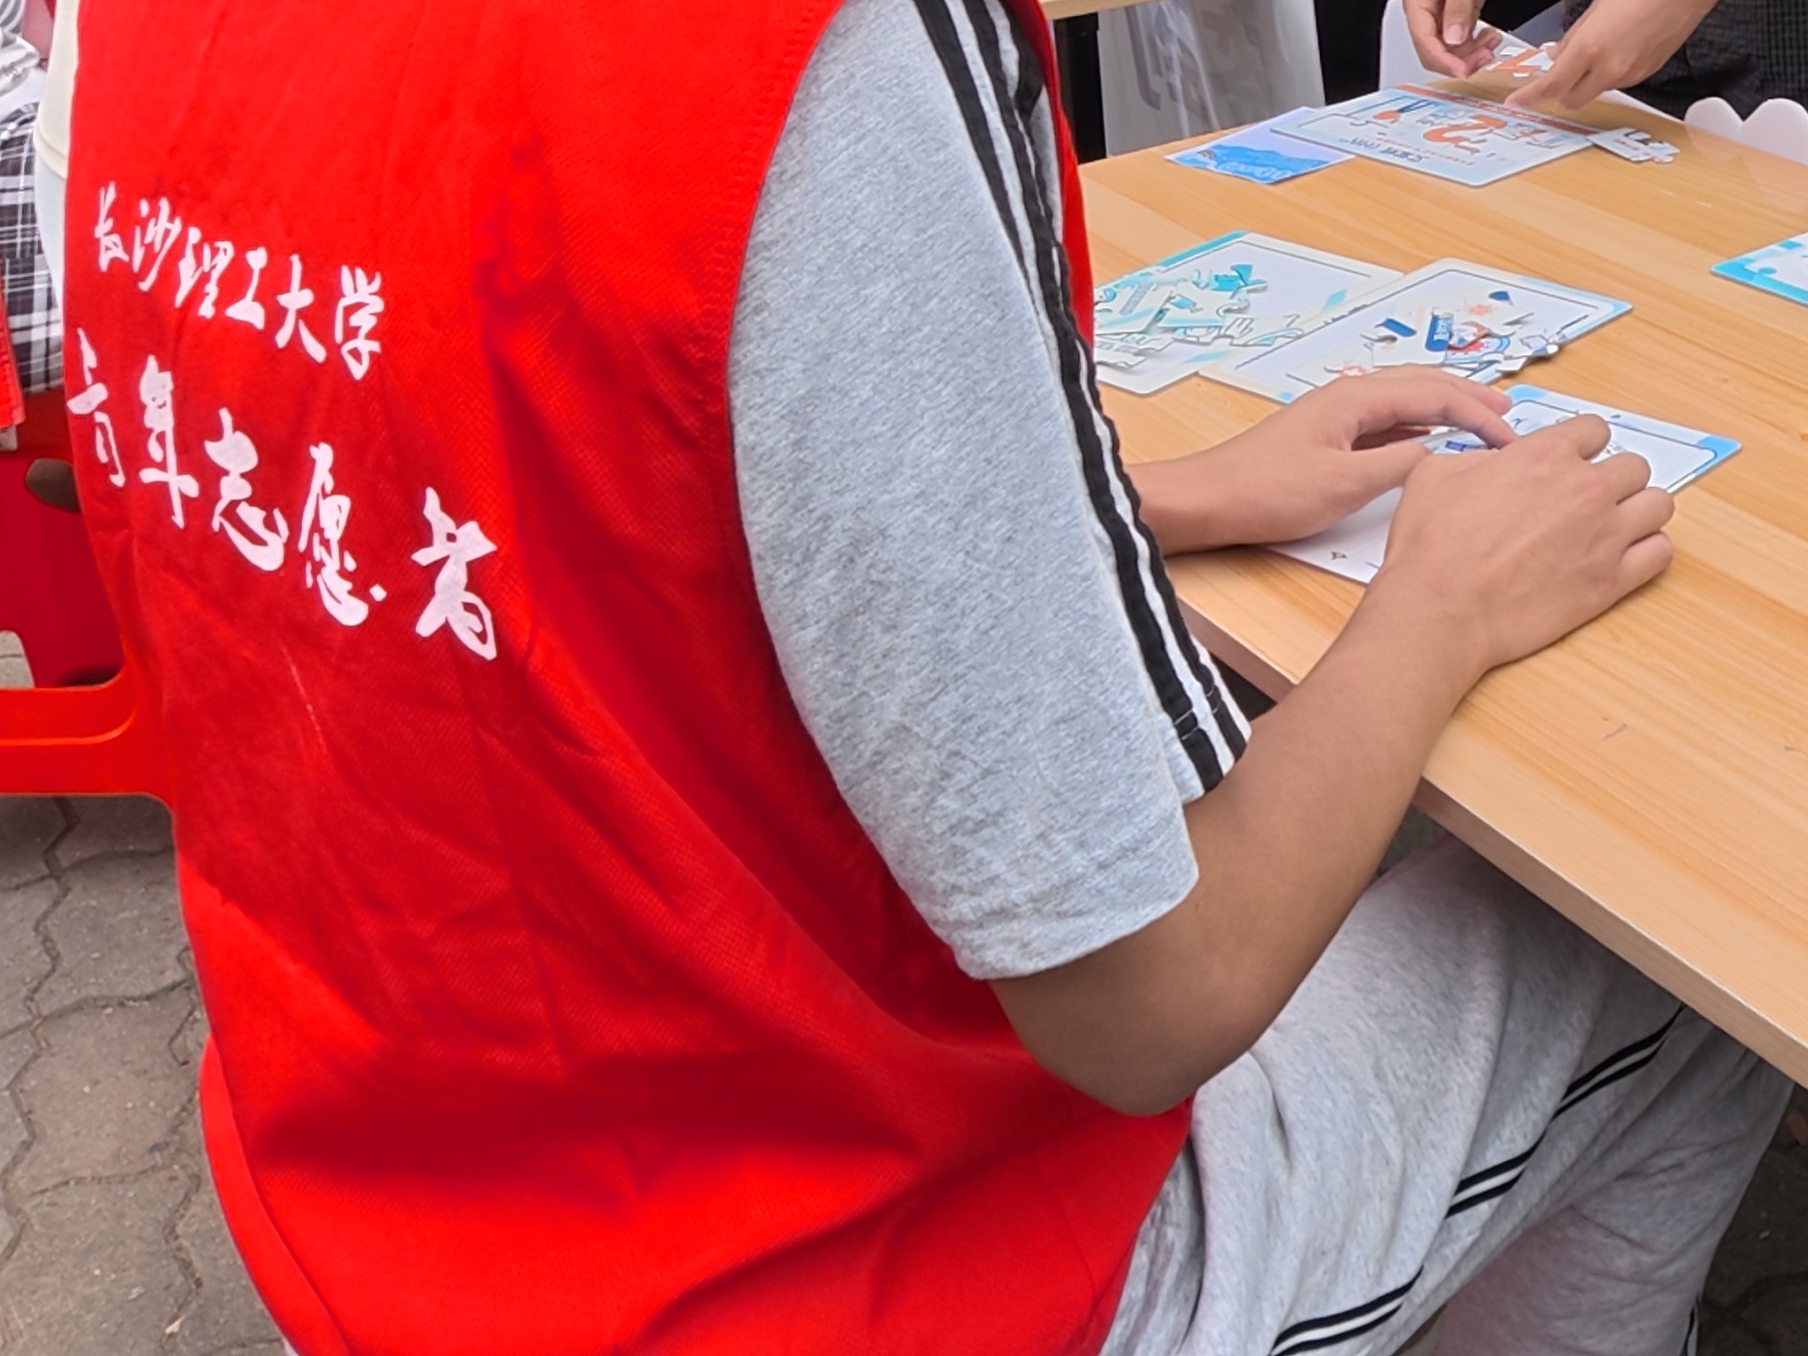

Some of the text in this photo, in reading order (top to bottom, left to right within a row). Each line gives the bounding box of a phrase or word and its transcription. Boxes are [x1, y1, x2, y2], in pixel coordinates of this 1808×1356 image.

[93, 178, 386, 380] 长沙理工大学
[66, 326, 499, 662] 青年志愿者
